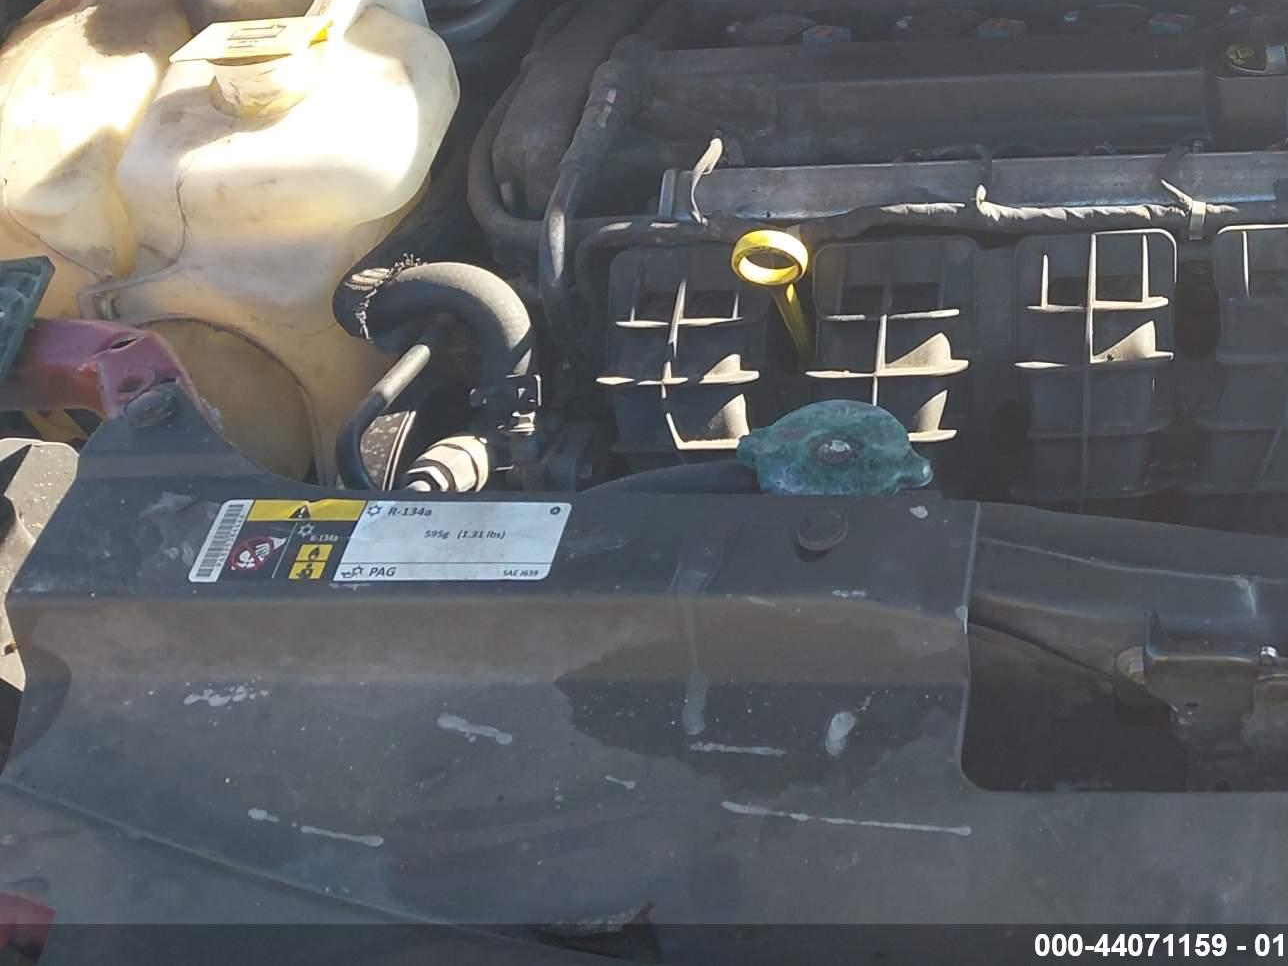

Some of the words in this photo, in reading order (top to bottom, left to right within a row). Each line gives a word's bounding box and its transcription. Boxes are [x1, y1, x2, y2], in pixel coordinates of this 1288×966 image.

[387, 507, 432, 517] R-134a
[424, 530, 450, 540] 595g
[457, 529, 484, 540] (1.31
[486, 529, 506, 540] lbs)
[369, 566, 396, 577] PAG
